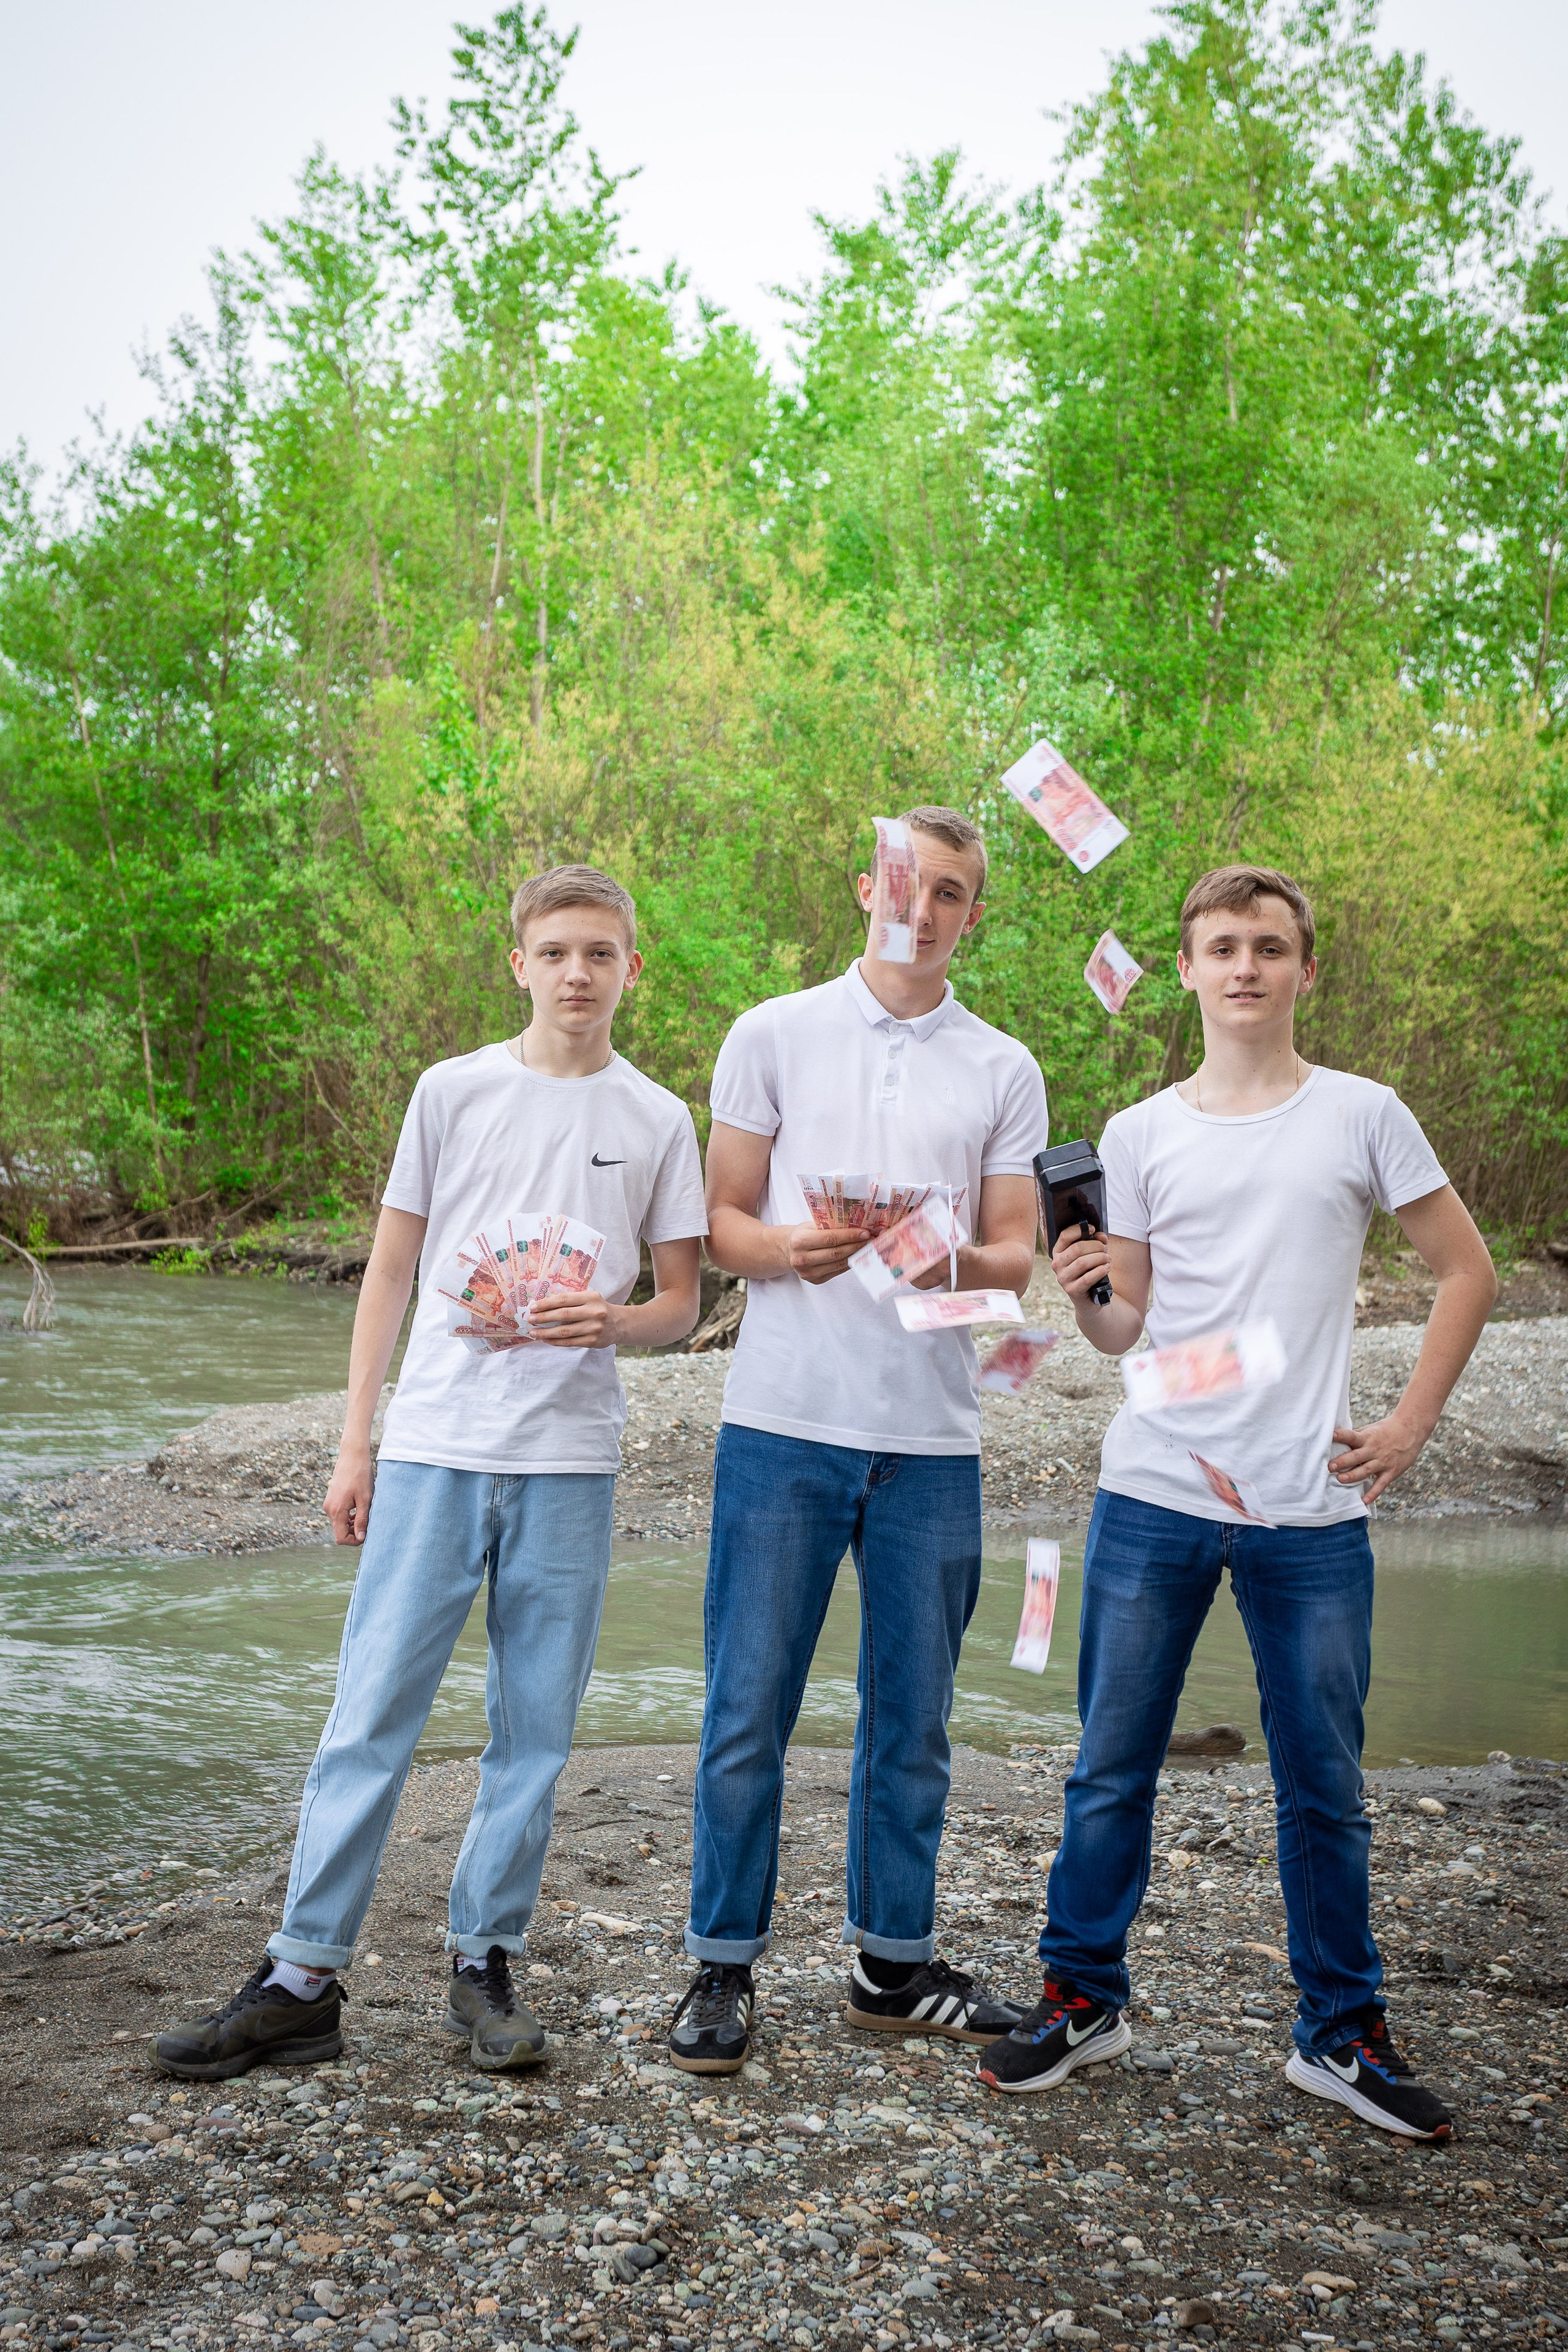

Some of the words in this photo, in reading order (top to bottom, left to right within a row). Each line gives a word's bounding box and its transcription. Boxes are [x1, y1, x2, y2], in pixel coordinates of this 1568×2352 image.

[557, 1221, 568, 1242] ПРИКОЛОВ
[475, 1235, 488, 1258] ПРИКОЛОВ
[481, 1232, 492, 1254] ПРИКОЛОВ
[437, 1289, 459, 1302] ПРИКОЛОВ
[459, 1300, 473, 1309] БАНКА
[518, 1284, 528, 1306] 5000
[472, 1306, 485, 1315] БИЛЕТ
[498, 1314, 519, 1331] 5000
